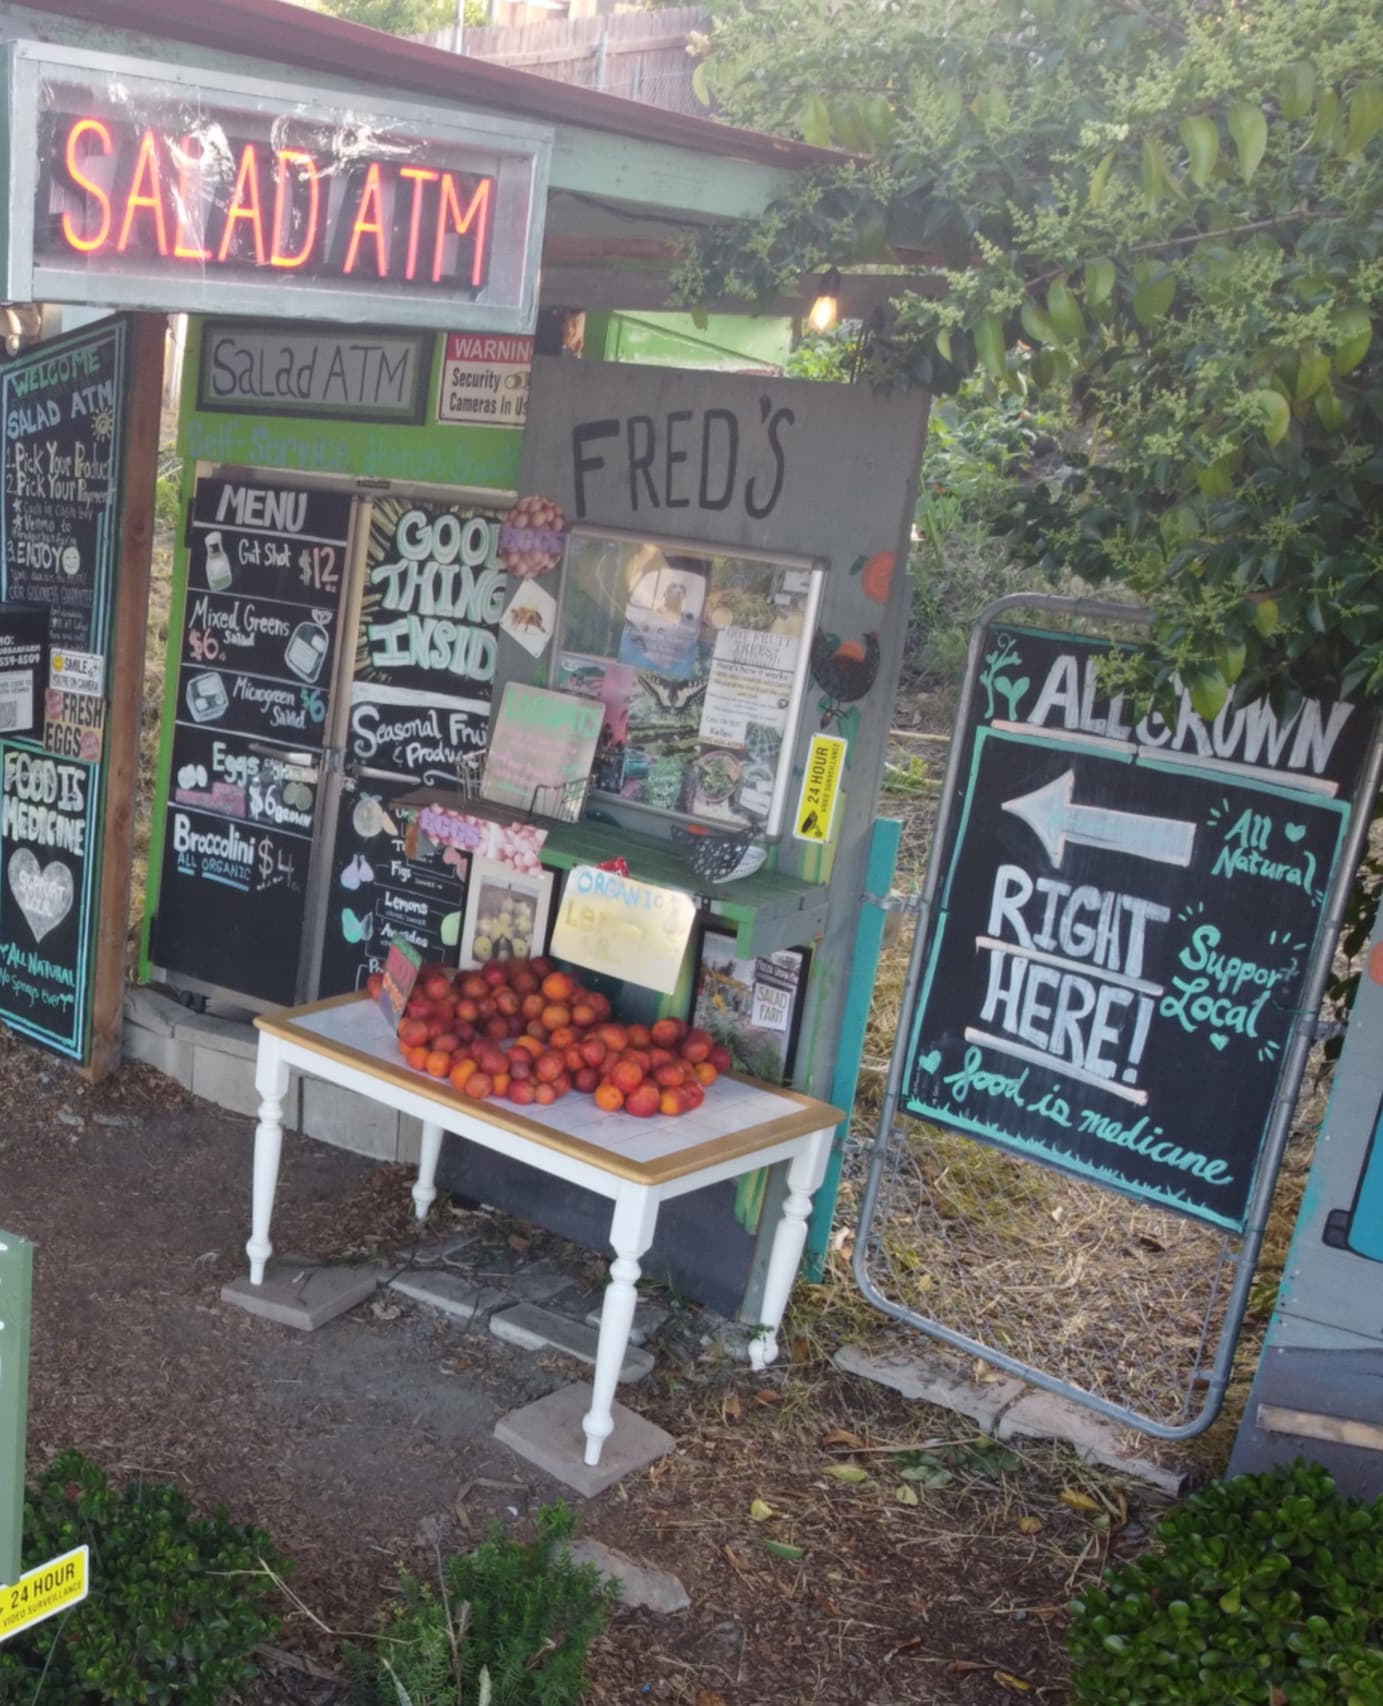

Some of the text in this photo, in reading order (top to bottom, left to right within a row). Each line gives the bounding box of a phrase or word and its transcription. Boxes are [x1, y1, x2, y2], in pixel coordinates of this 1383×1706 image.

[61, 117, 495, 287] SALAD ATM
[10, 347, 101, 397] WELCOME
[454, 338, 533, 362] WARNIN
[322, 344, 410, 404] ATM
[452, 367, 501, 392] Security
[7, 379, 113, 439] SALAD ATM
[449, 392, 497, 416] Cameras
[515, 396, 529, 417] Us
[15, 441, 43, 475] Pick
[46, 440, 72, 476] Your
[572, 394, 795, 519] FRED'S
[17, 472, 46, 498] Pick
[215, 484, 308, 533] MENU
[17, 541, 63, 573] ENJOY
[238, 538, 261, 566] Gut
[265, 542, 292, 568] Shot
[371, 558, 509, 624] THING
[188, 595, 291, 636] Mixed Greens
[64, 656, 88, 674] SMILE
[368, 615, 498, 681] INSID
[62, 692, 105, 729] FRESH
[233, 676, 325, 723] Microgreen $6
[45, 722, 82, 758] EGGS
[352, 705, 441, 758] Seasonal
[448, 712, 489, 747] Frui
[405, 740, 479, 768] Produ
[3, 751, 86, 812] FOOD IS
[212, 741, 261, 786] Eggs
[807, 746, 829, 805] 24 HOUR
[2, 794, 86, 857] MEDICINE
[173, 813, 256, 866] Broccolini
[1224, 808, 1273, 852] All
[178, 853, 253, 881] ALL ORGANIC
[391, 860, 412, 882] Figs
[577, 870, 664, 911] ORGANIC
[1211, 847, 1317, 898] Natural
[384, 890, 429, 916] Lemons
[986, 864, 1172, 979] RIGHT
[1178, 924, 1301, 993] Support
[979, 944, 1155, 1085] HERE!
[1159, 976, 1272, 1040] Local
[1026, 1083, 1072, 1128] is
[3, 1580, 82, 1628] VIDEO SURVEILLANCE
[10, 1561, 75, 1609] 24 HOUR
